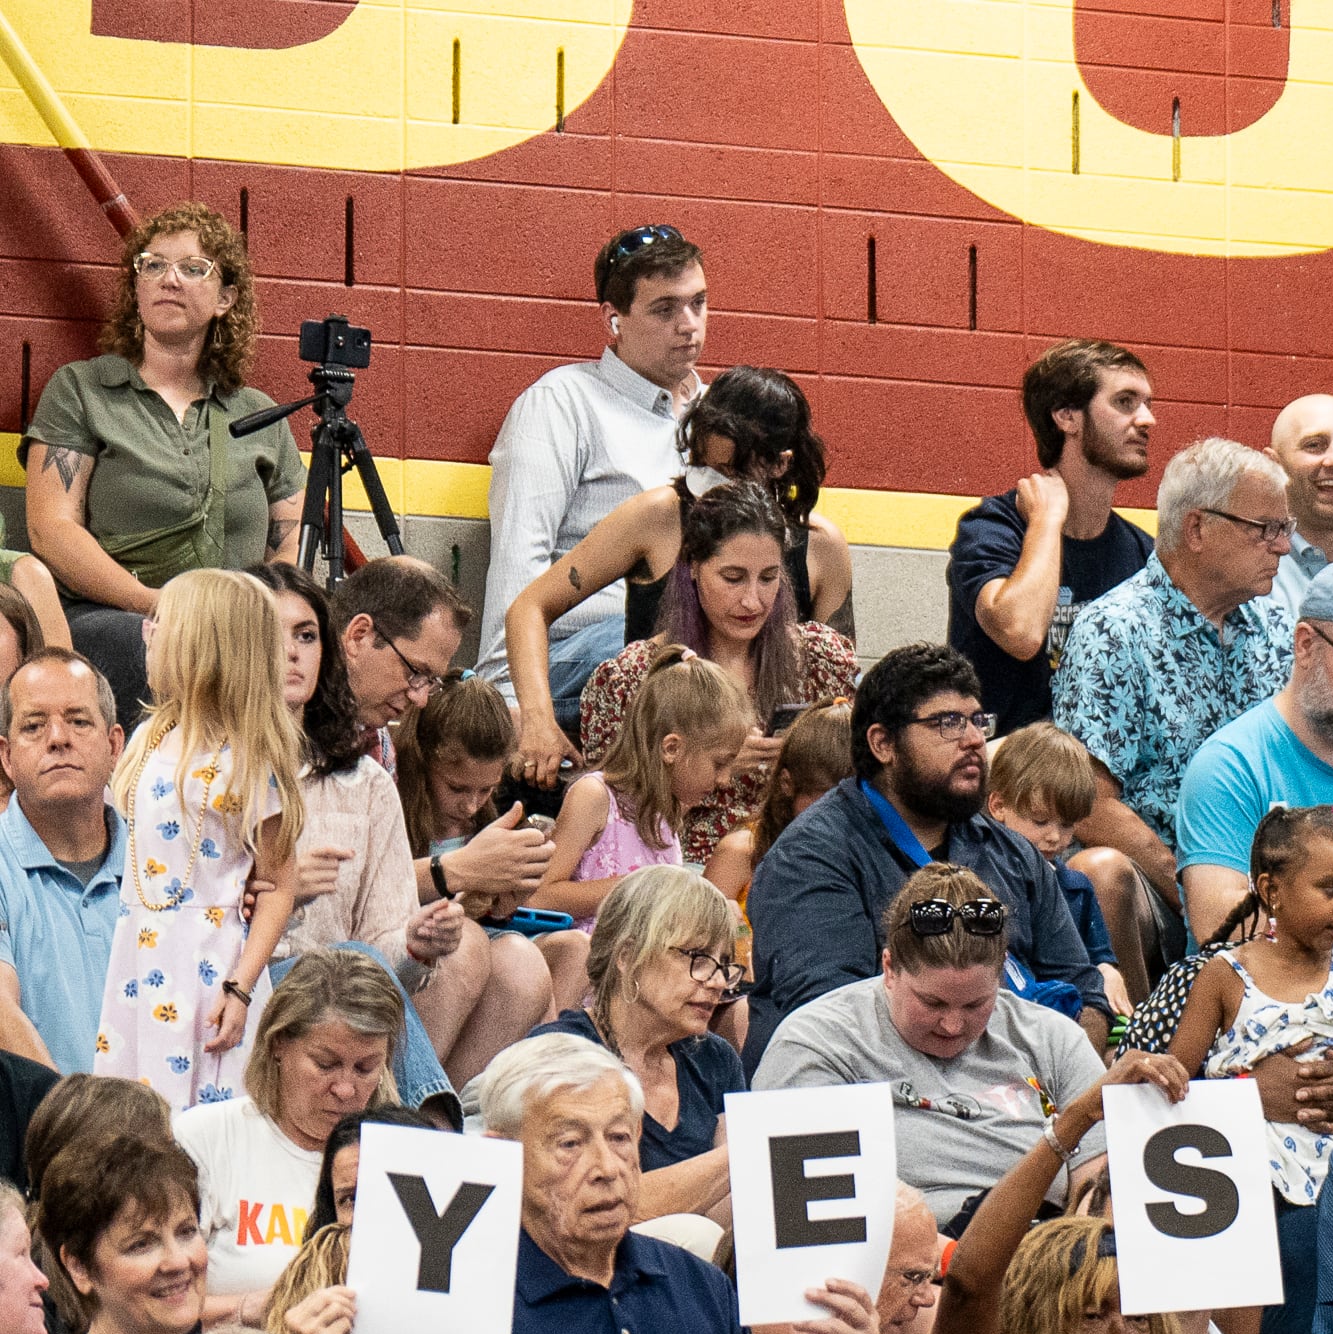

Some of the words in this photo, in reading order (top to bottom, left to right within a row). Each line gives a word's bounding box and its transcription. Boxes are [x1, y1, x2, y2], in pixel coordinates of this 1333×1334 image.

[387, 1172, 496, 1295] Y
[769, 1129, 867, 1250] E
[1143, 1123, 1240, 1240] S
